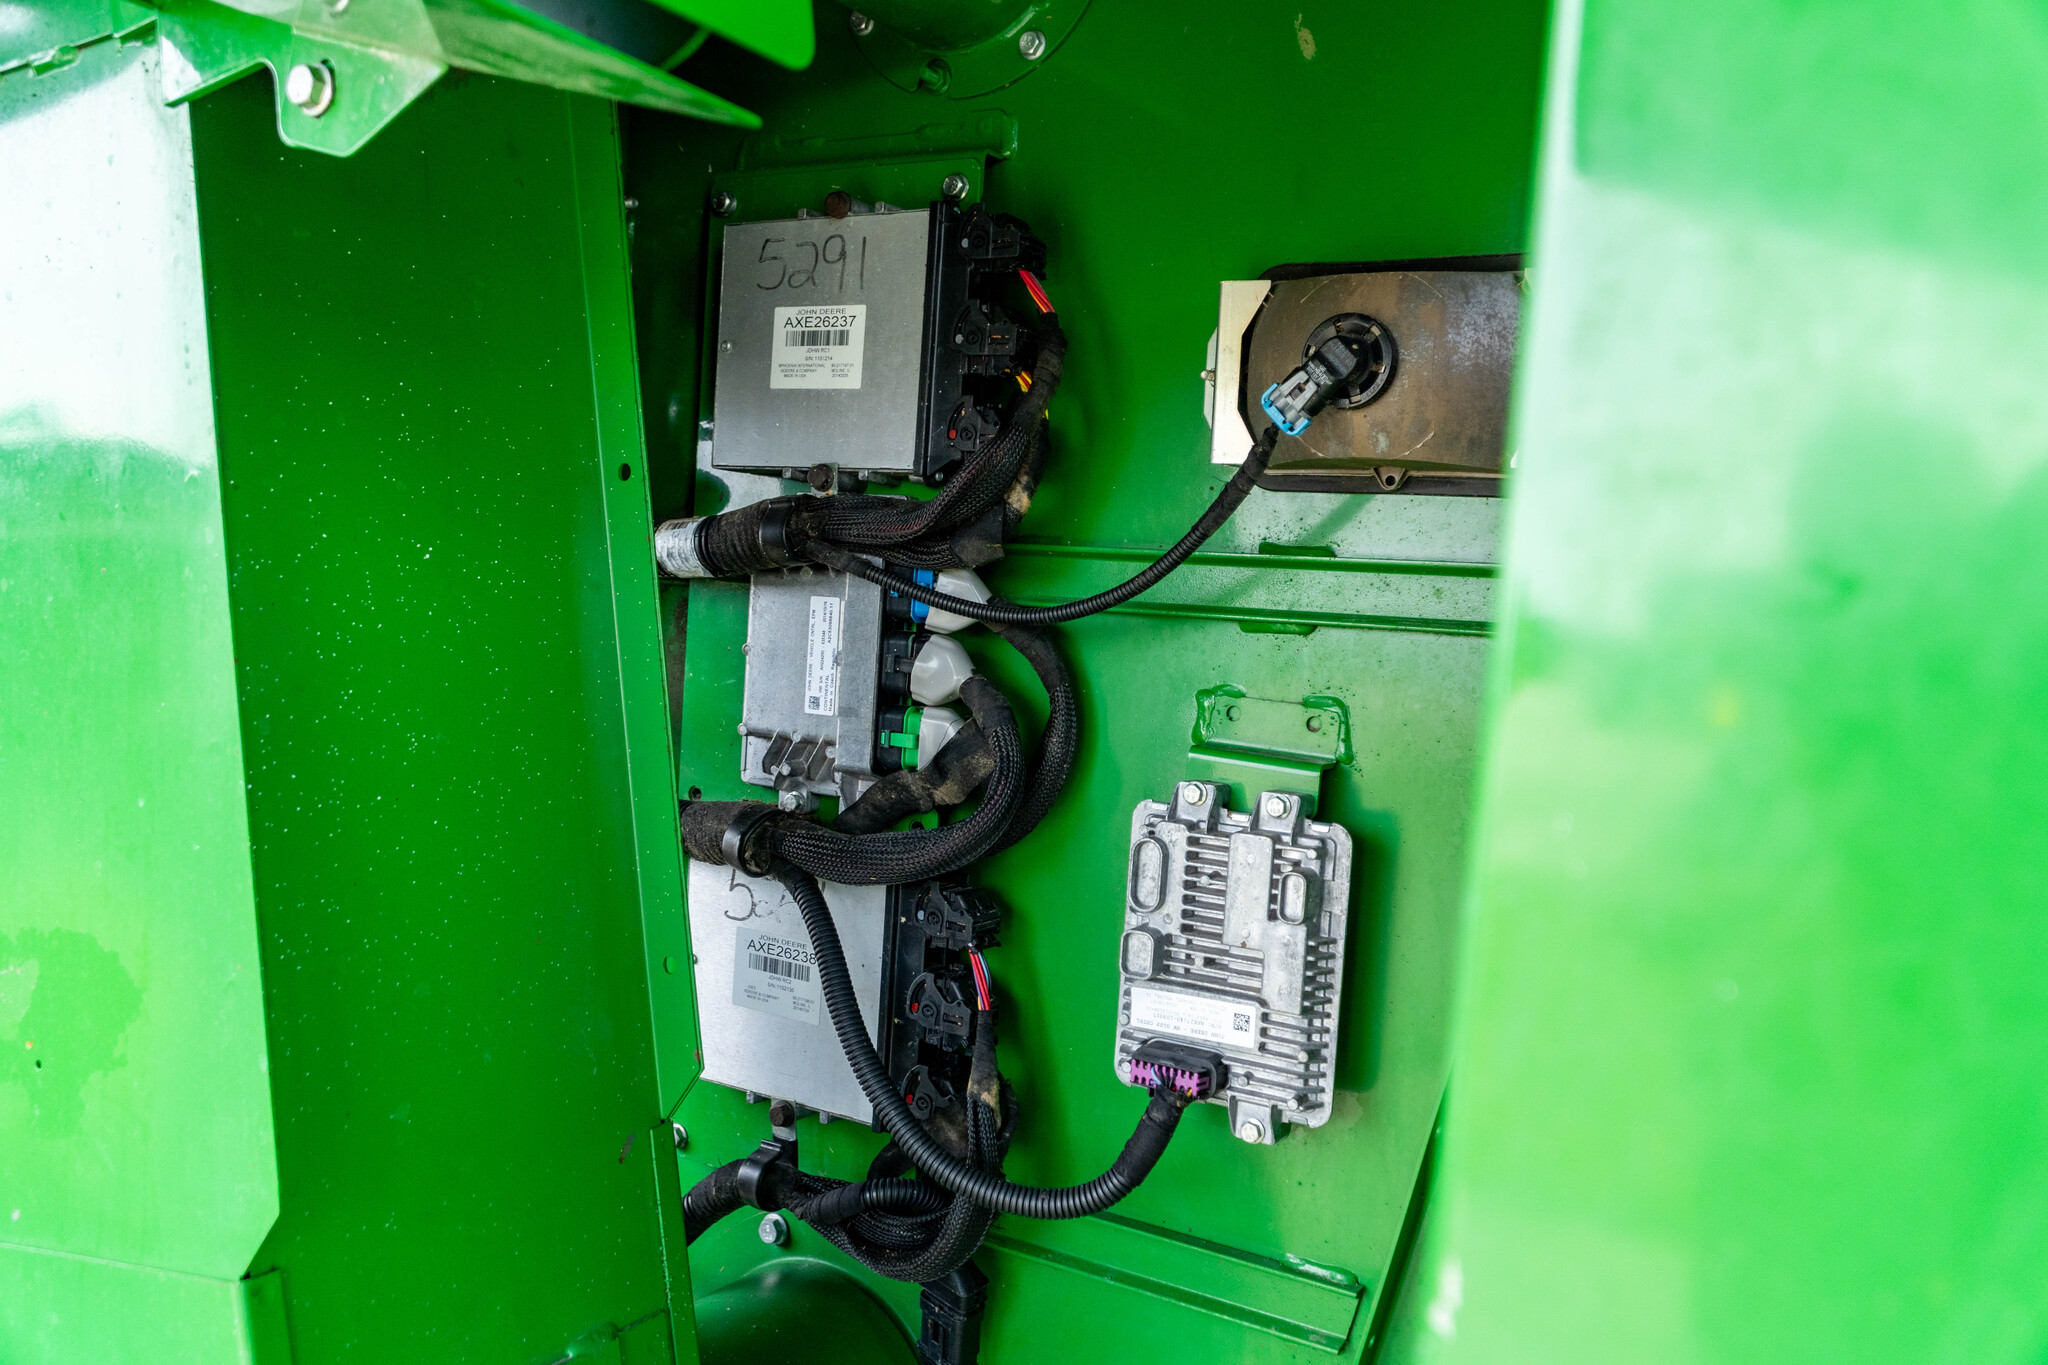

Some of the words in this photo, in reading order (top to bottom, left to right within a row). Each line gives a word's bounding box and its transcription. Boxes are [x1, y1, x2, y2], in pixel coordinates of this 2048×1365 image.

[756, 233, 866, 293] 5291
[784, 315, 857, 328] AXE26237
[759, 934, 780, 944] JOHN
[781, 939, 808, 950] DEERE
[747, 939, 817, 965] AXE26238
[1190, 1028, 1209, 1037] DEERE
[1211, 1031, 1225, 1039] JOHN
